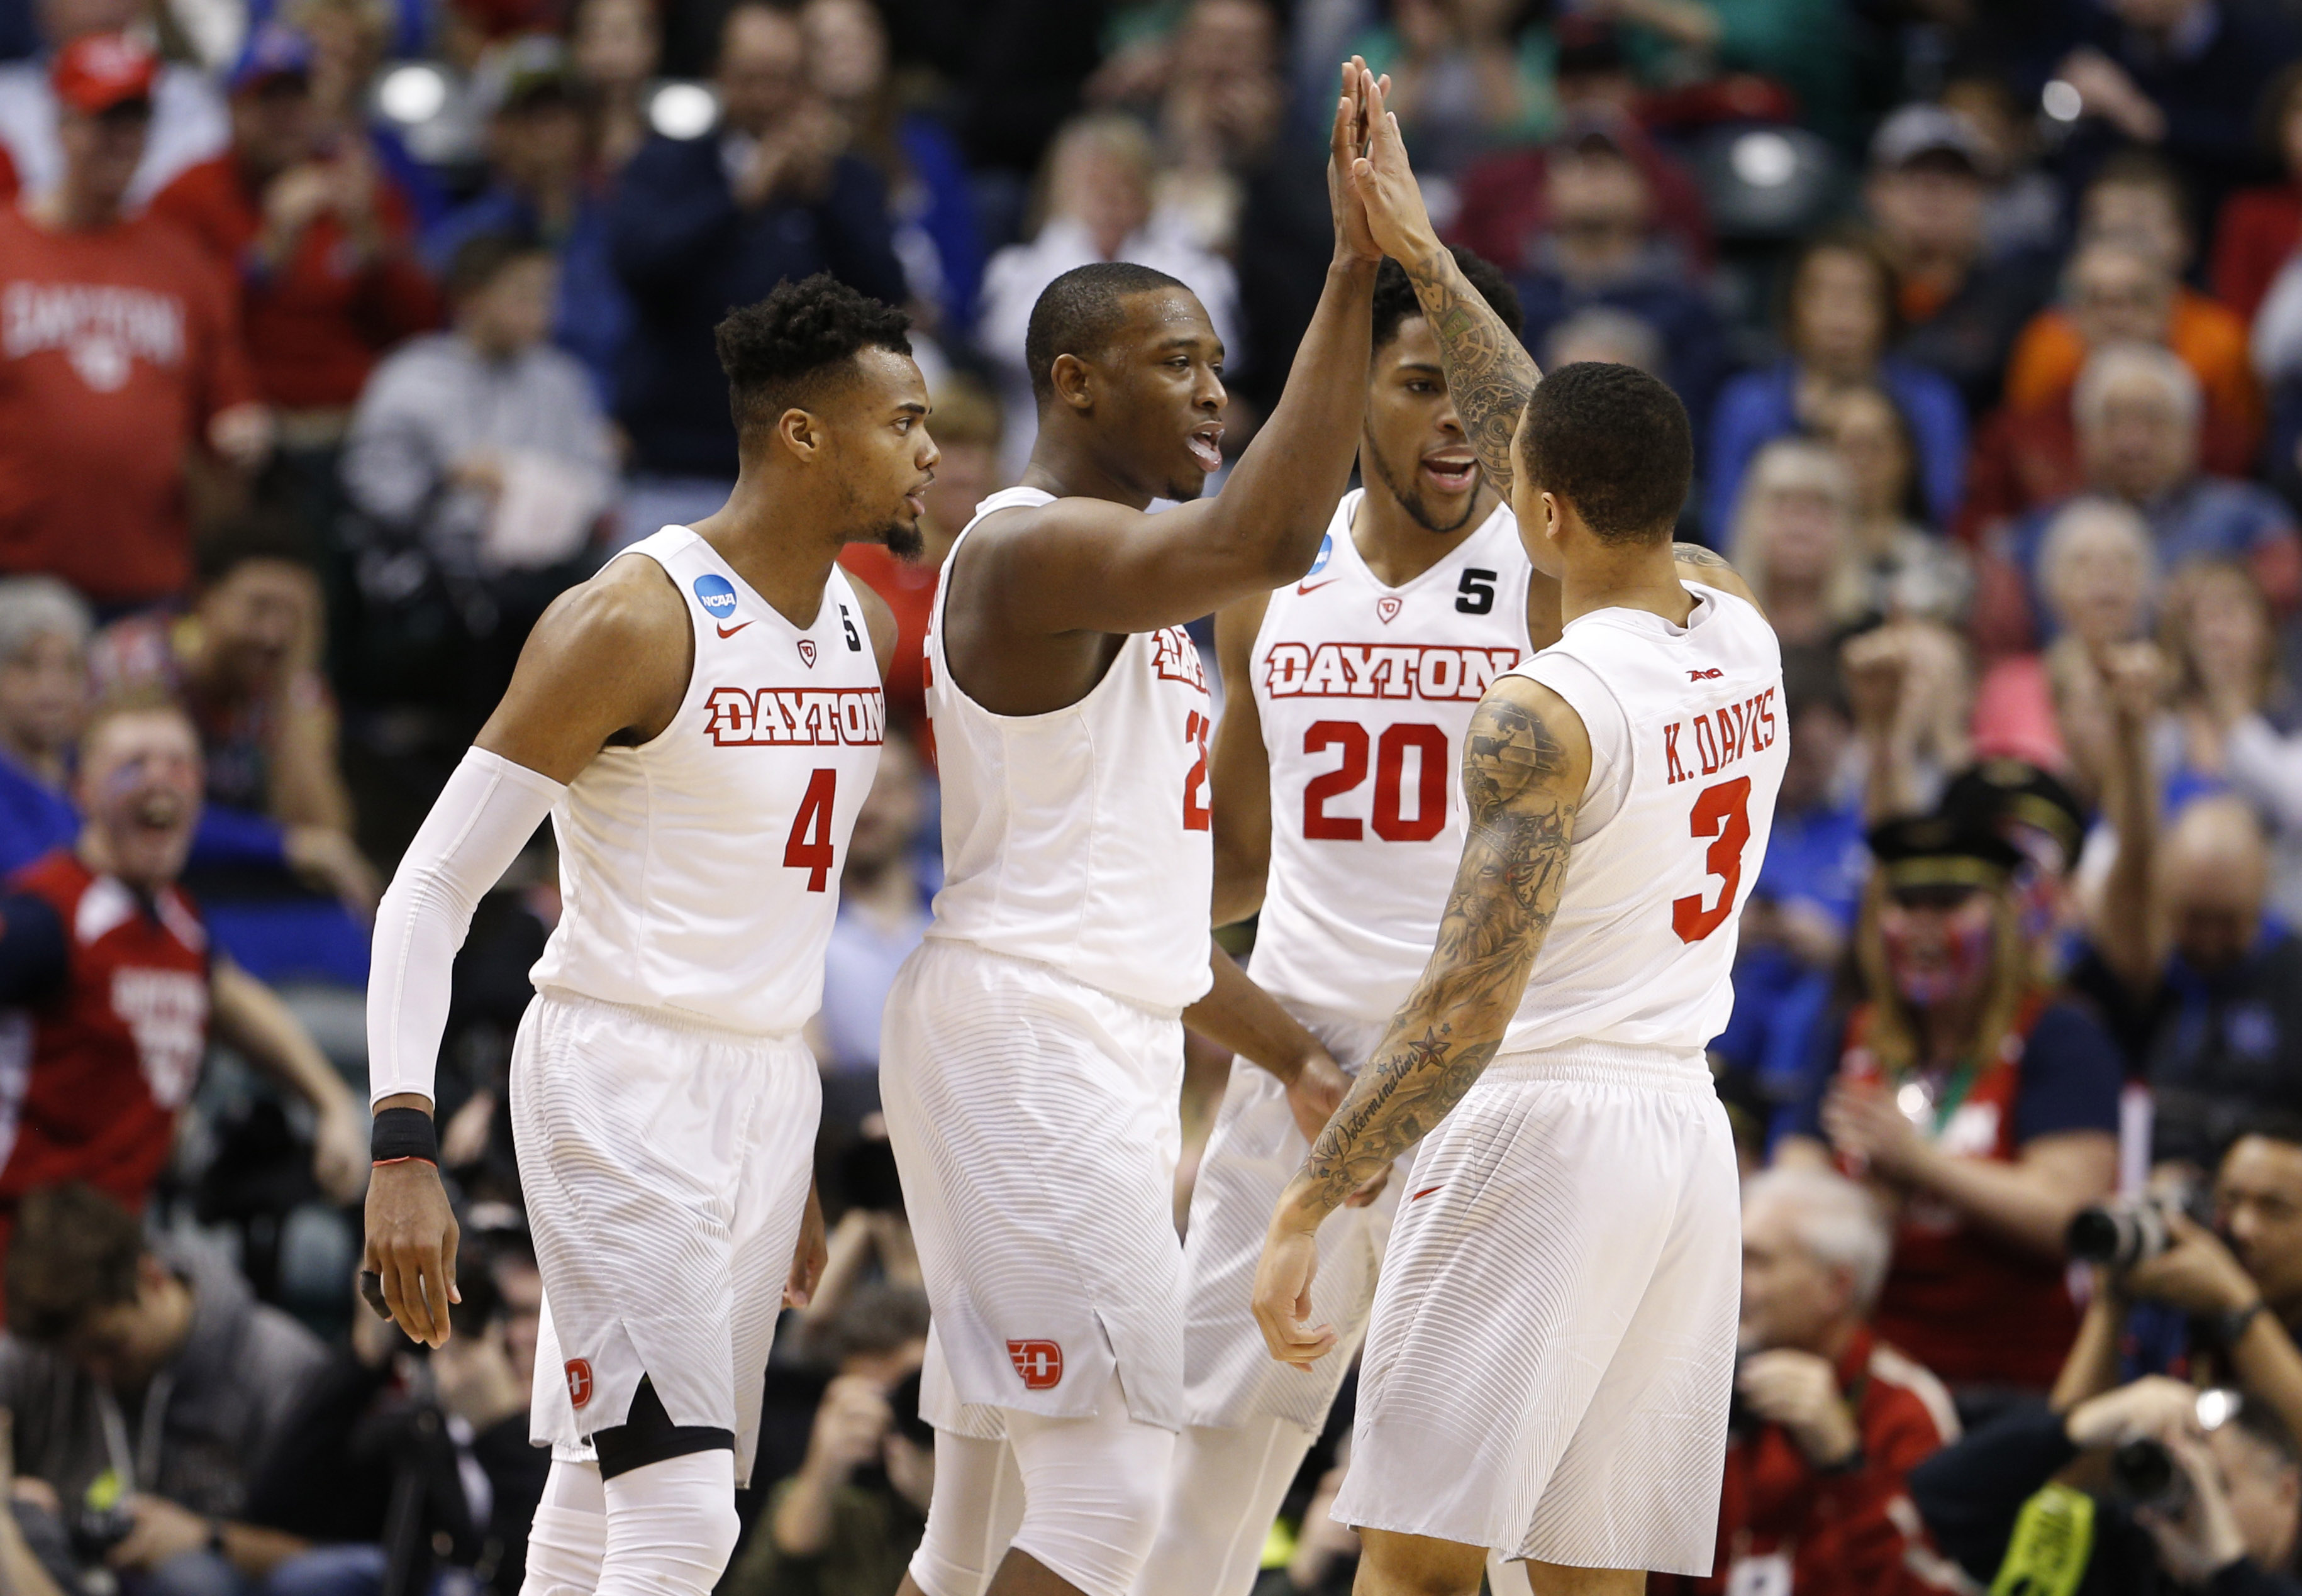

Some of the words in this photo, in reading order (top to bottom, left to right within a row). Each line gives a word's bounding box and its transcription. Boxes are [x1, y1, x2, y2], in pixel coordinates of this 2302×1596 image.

[701, 592, 736, 607] NCAA
[1455, 567, 1498, 615] 5
[838, 603, 862, 651] 5
[1264, 642, 1520, 701] DAYTON
[703, 686, 884, 747] DAYTON
[1664, 722, 1694, 785] K.
[1693, 685, 1775, 777] DAVIS
[1303, 719, 1448, 842] 20
[782, 768, 837, 892] 4
[1672, 775, 1751, 945] 3
